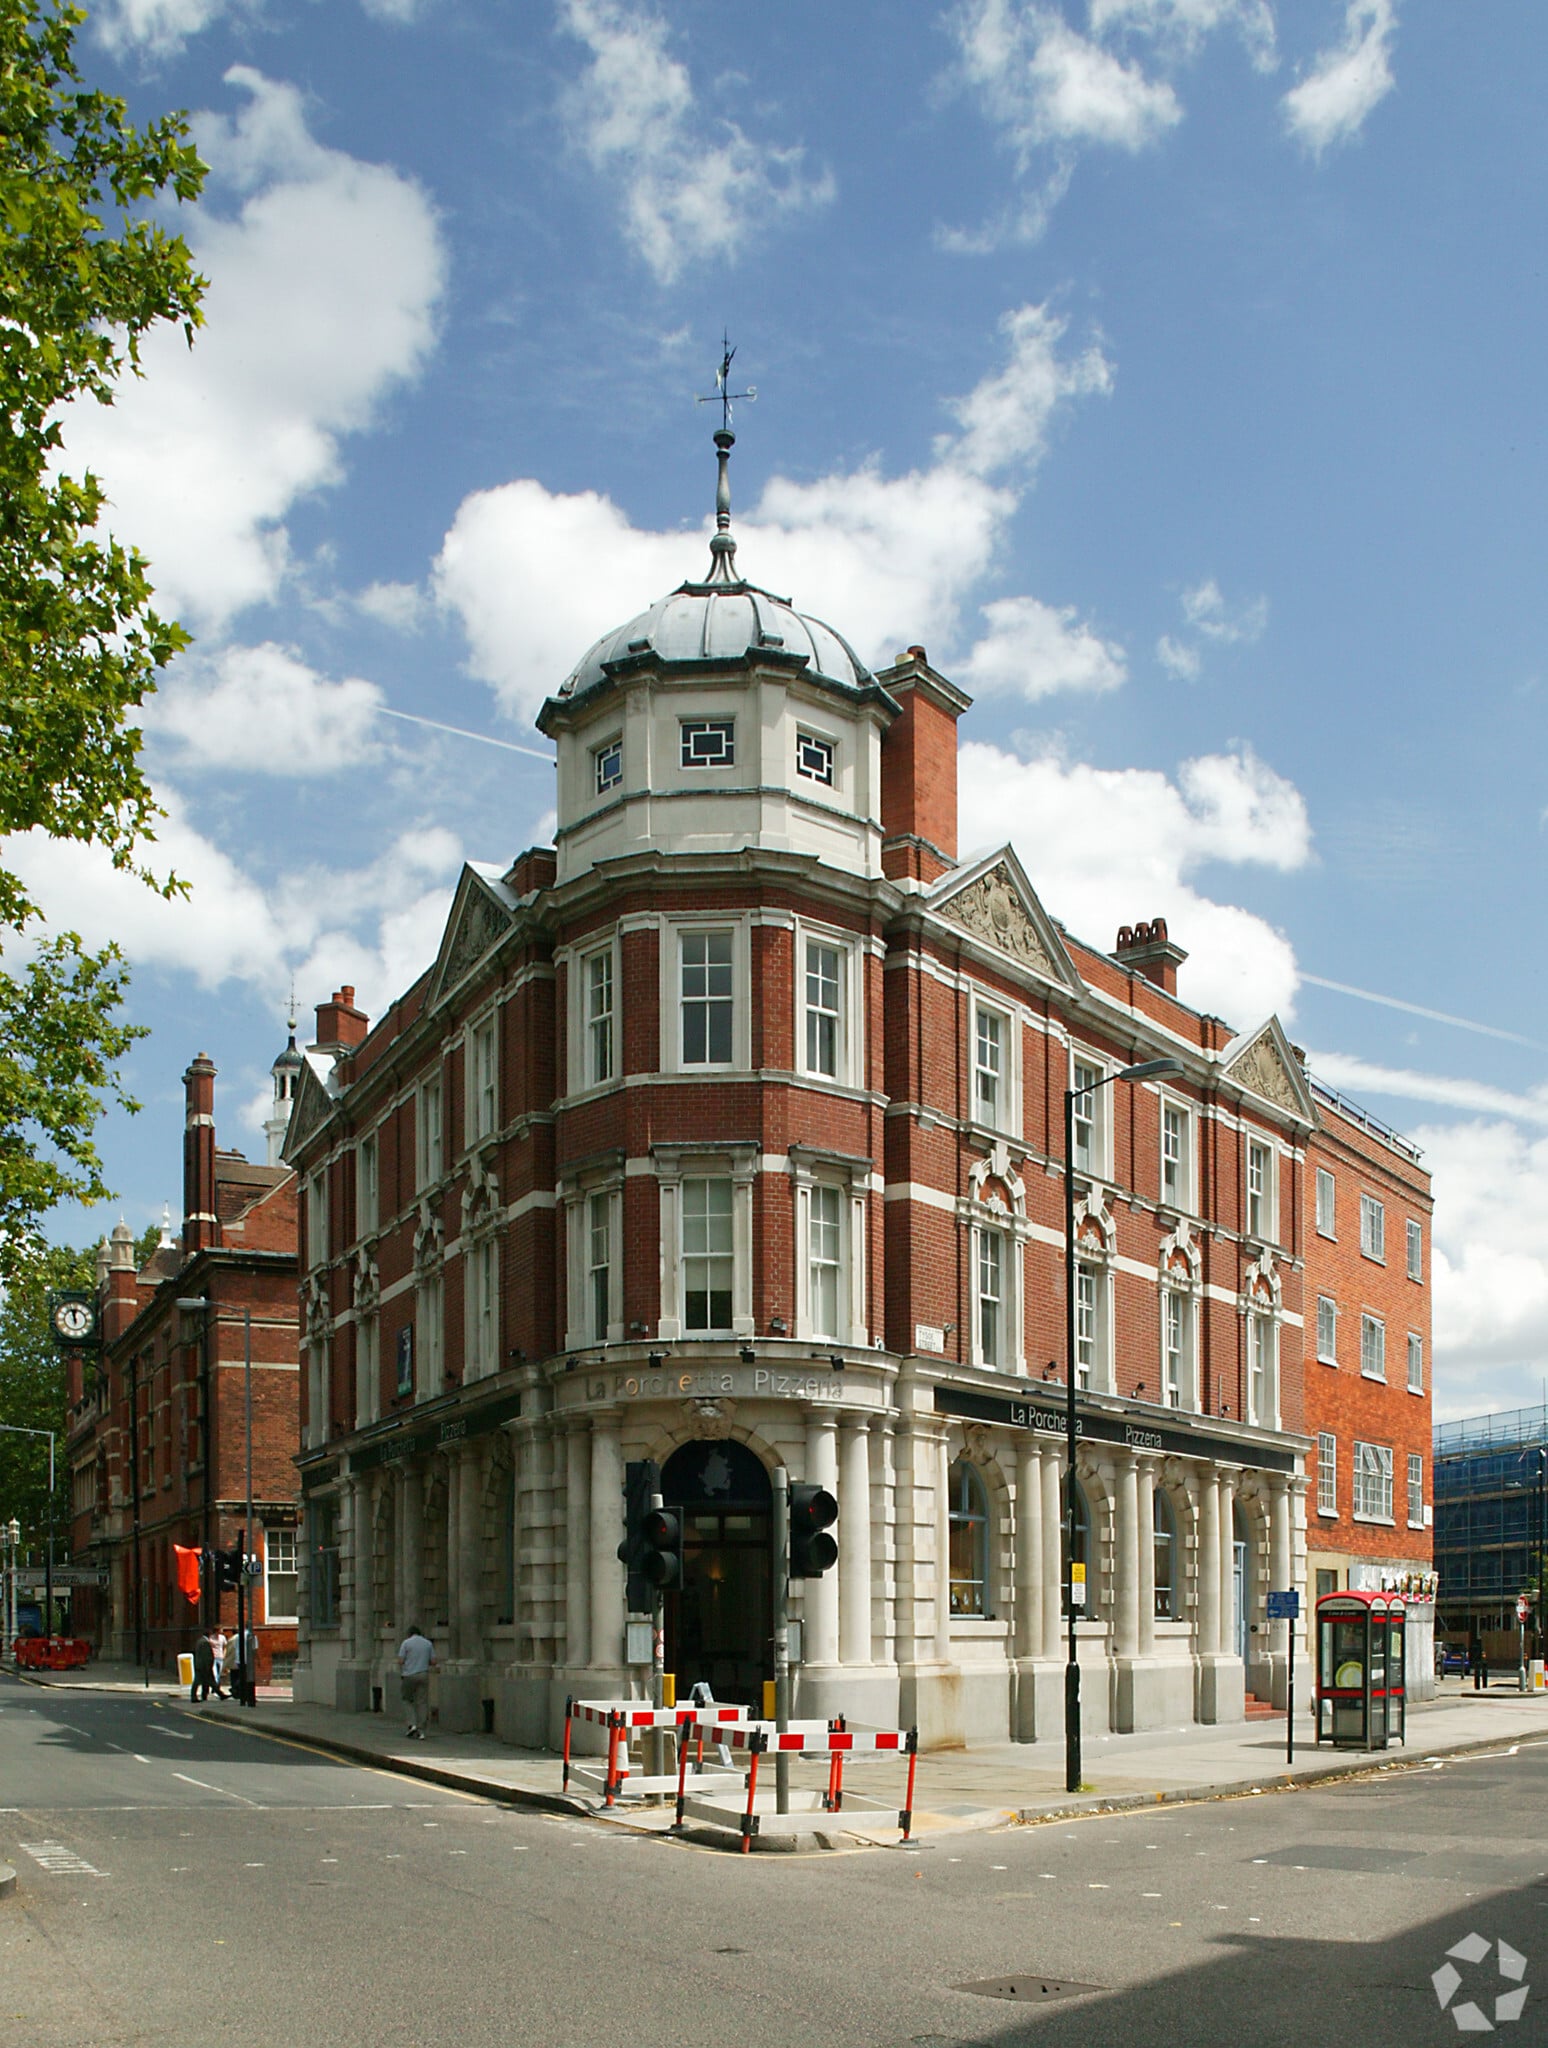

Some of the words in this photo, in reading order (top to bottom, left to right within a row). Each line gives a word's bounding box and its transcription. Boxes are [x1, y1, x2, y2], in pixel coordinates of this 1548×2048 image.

[586, 1377, 605, 1401] La
[614, 1370, 733, 1397] Porchetta
[754, 1369, 843, 1399] Pizzeria
[1011, 1403, 1025, 1424] La
[1028, 1406, 1083, 1434] Porchea
